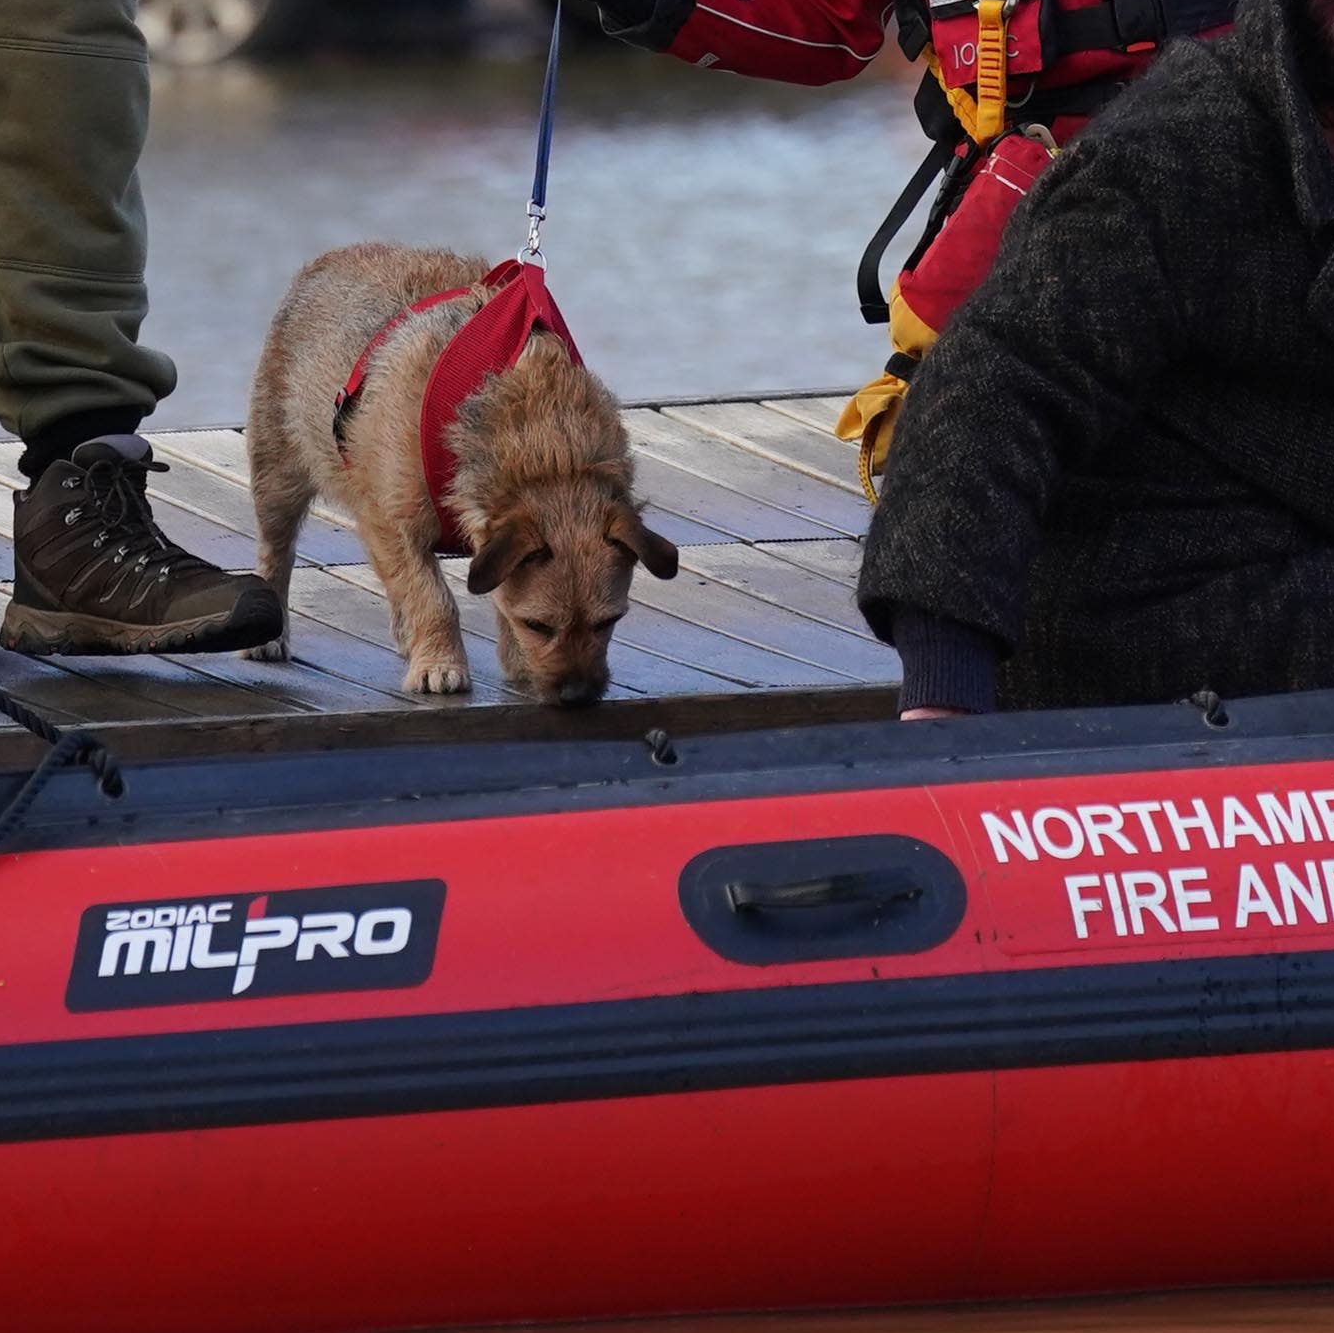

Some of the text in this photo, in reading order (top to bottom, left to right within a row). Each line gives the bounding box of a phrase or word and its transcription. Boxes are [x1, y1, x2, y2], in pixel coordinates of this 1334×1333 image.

[105, 901, 234, 932] ZODIAC
[1064, 865, 1220, 940] FIRE
[97, 904, 413, 996] MILPRO
